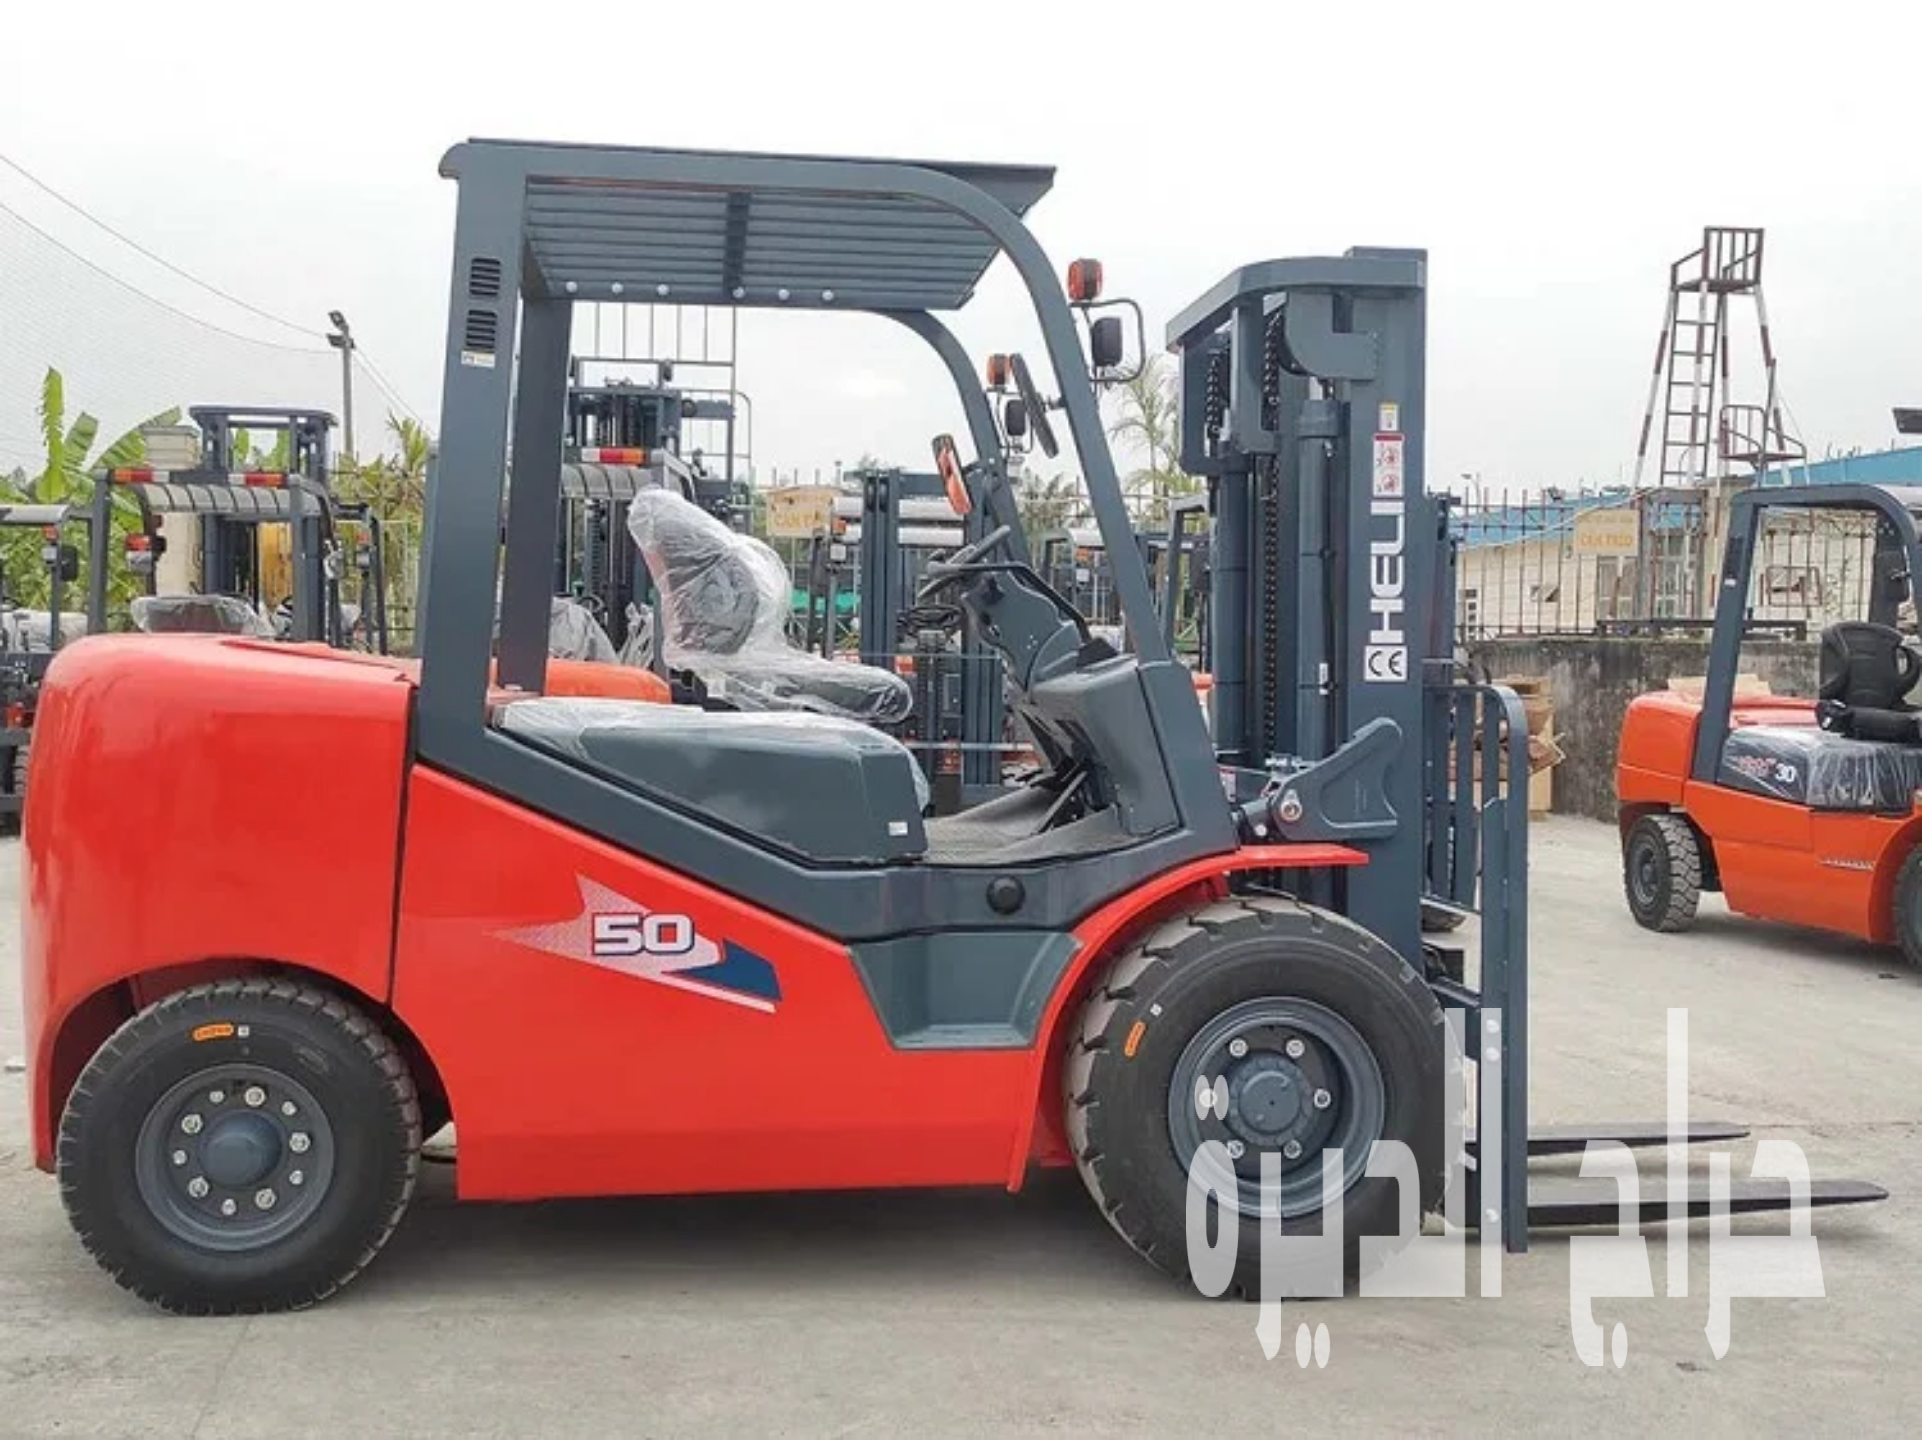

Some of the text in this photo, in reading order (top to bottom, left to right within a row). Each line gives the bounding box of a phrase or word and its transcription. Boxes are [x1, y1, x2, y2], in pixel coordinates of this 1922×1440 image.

[1370, 501, 1405, 644] HELI
[1368, 650, 1403, 677] CE
[1774, 762, 1797, 783] 30
[591, 912, 695, 956] 50
